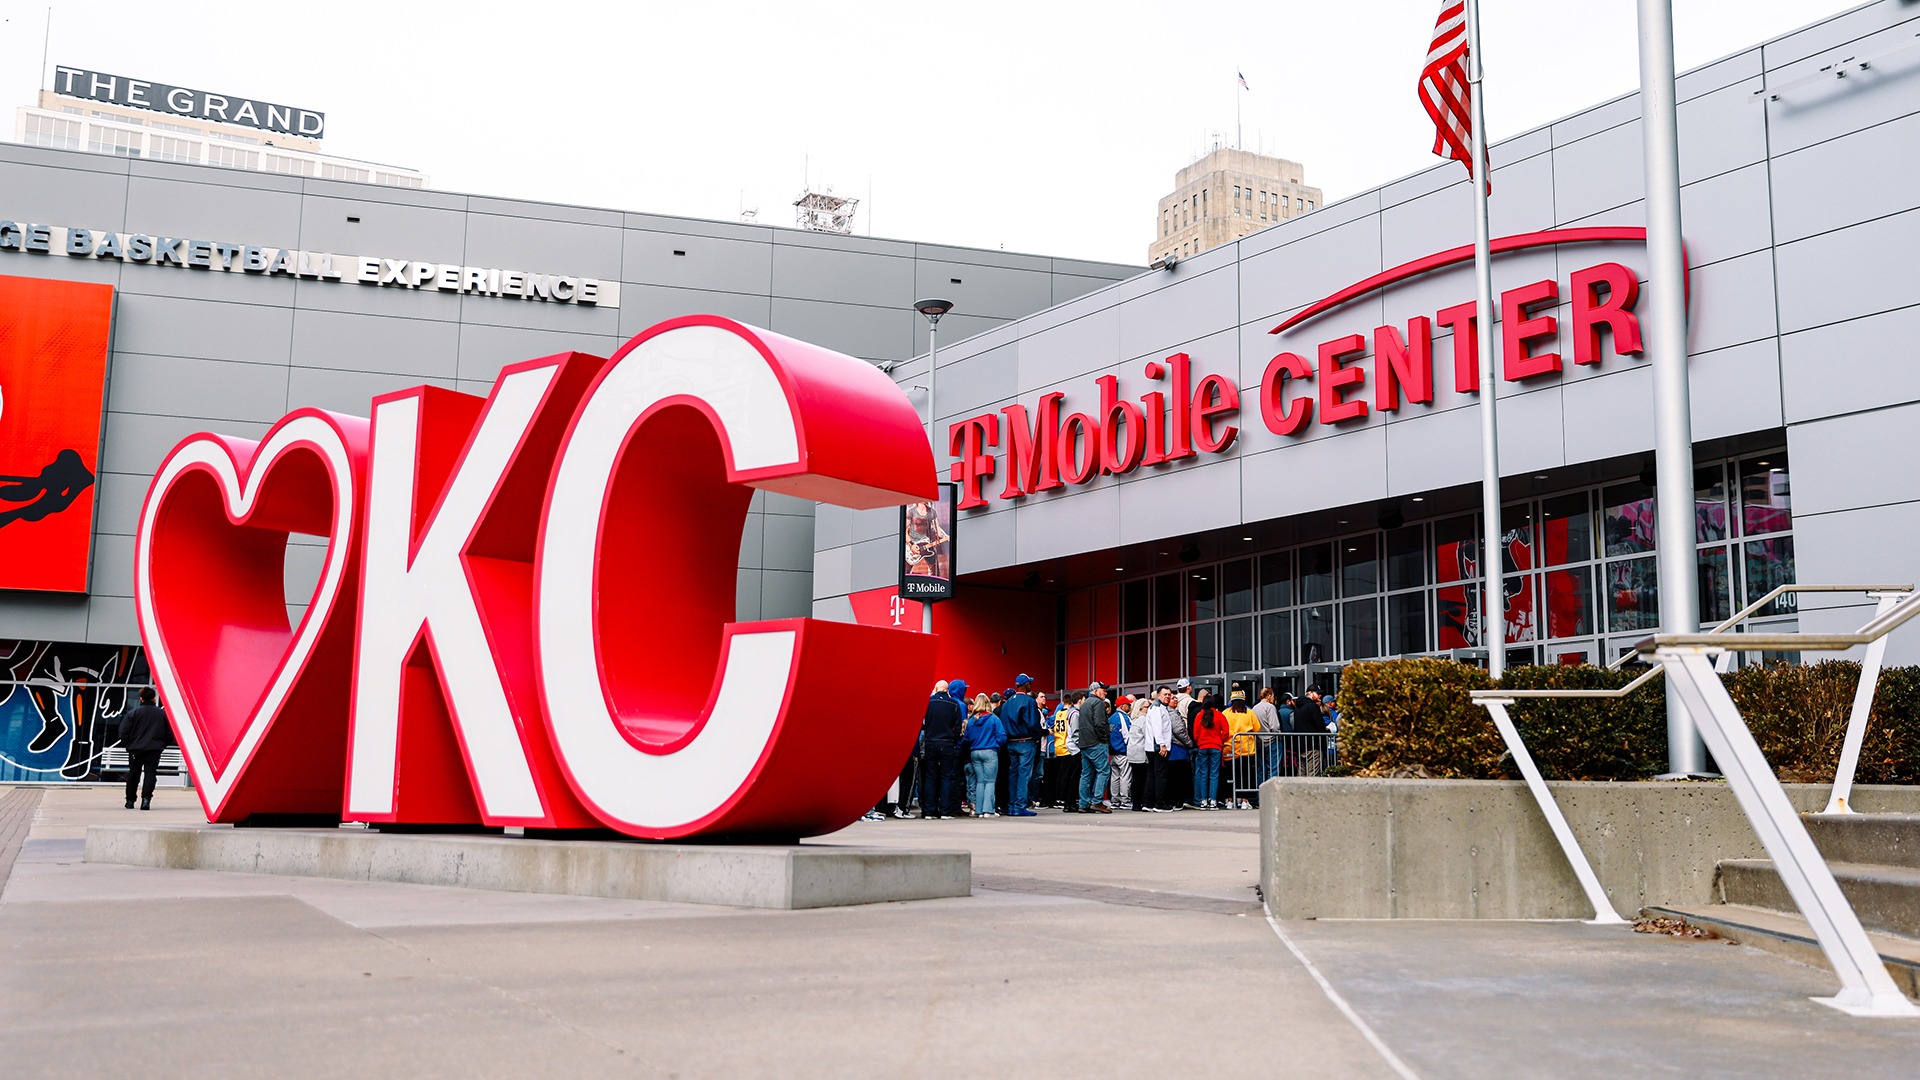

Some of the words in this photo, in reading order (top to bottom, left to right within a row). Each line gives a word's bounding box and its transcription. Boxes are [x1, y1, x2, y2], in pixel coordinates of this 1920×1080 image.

[57, 67, 151, 106] THE
[167, 88, 324, 135] GRAND
[67, 227, 341, 281] BASKETBALL
[358, 256, 598, 305] EXPERIENCE
[1260, 262, 1644, 437] CENTER
[346, 314, 805, 840] KC
[1775, 592, 1796, 609] 140
[1056, 719, 1066, 732] 33
